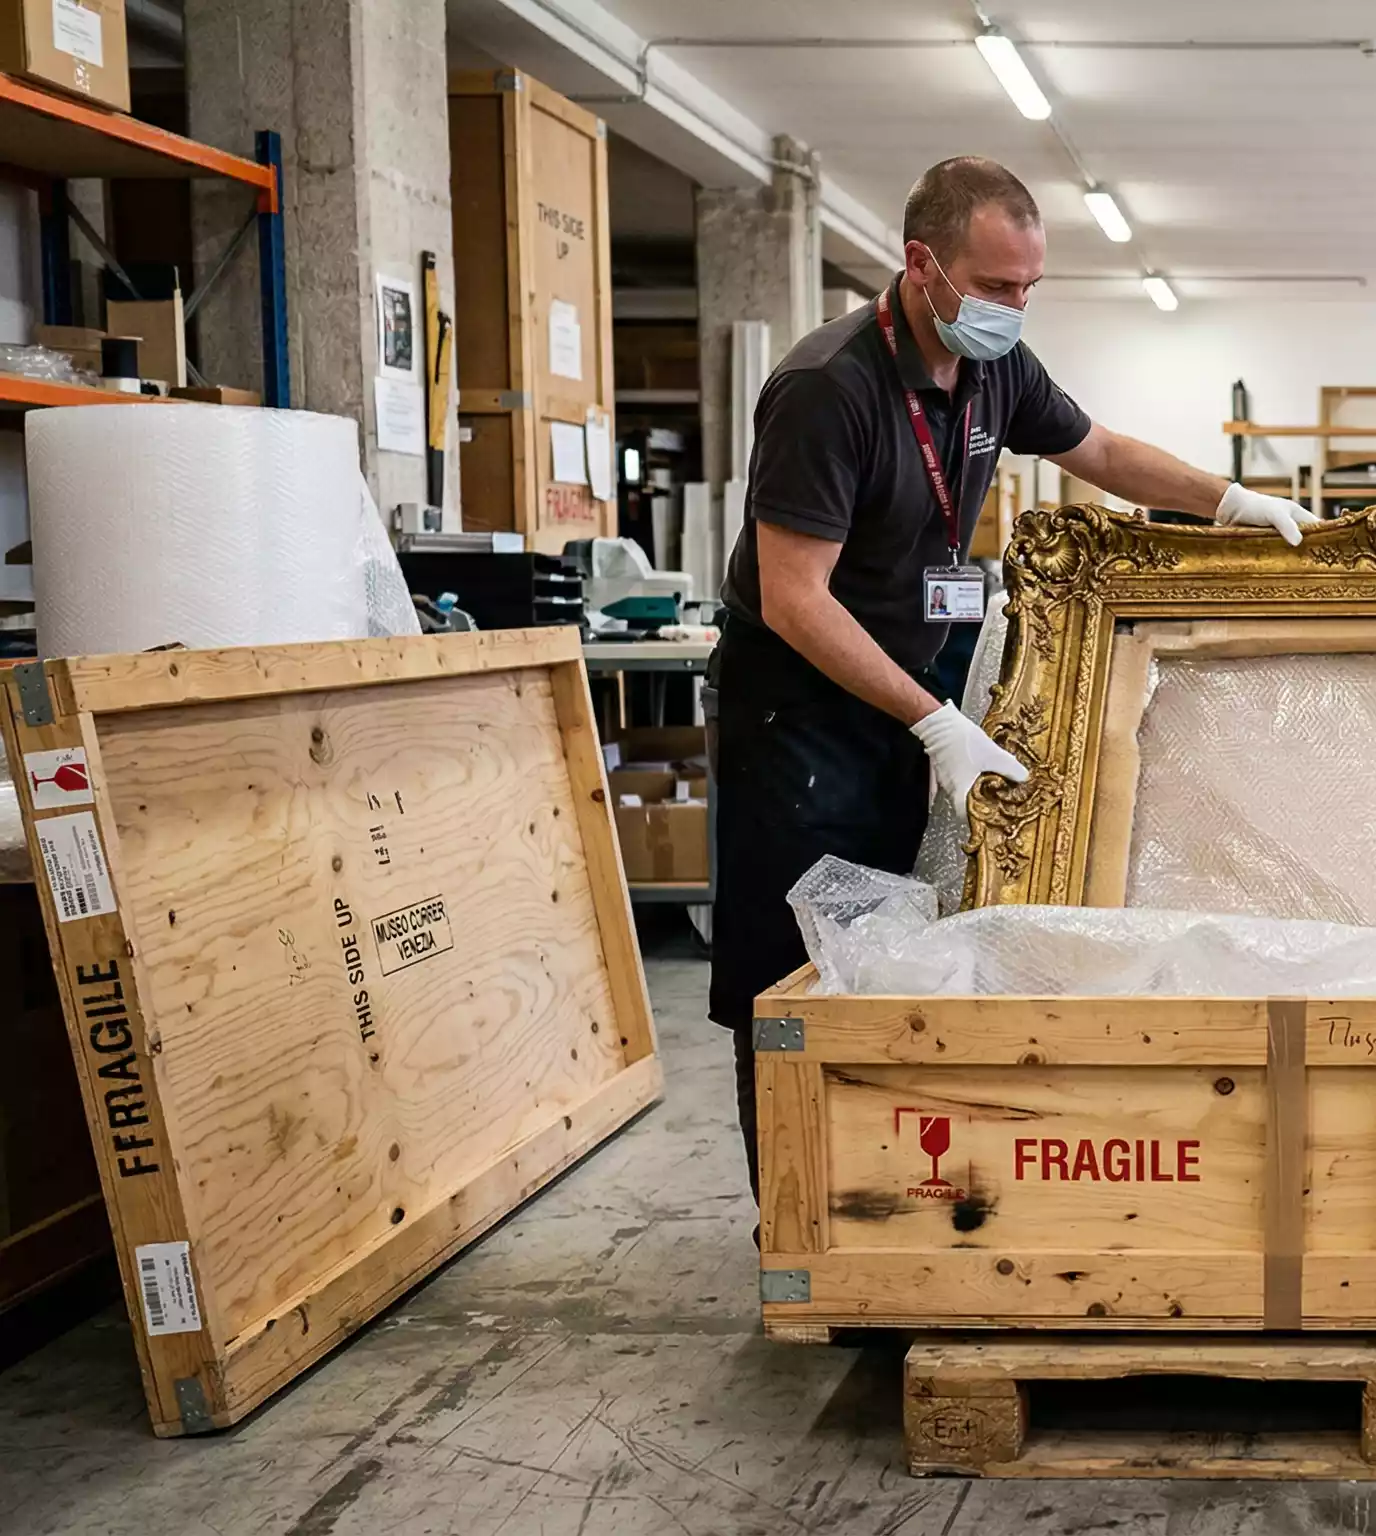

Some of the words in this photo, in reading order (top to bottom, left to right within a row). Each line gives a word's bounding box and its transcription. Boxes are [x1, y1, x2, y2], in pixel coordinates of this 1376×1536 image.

[537, 202, 560, 229] THIS
[562, 213, 585, 241] SIDE
[556, 238, 569, 259] UP
[334, 898, 353, 928] UP
[376, 914, 408, 944] MUSEO
[341, 934, 364, 985] SIDE
[354, 990, 375, 1043] THIS
[1015, 1139, 1201, 1182] FRAGILE
[907, 1187, 965, 1199] FRAGILE
